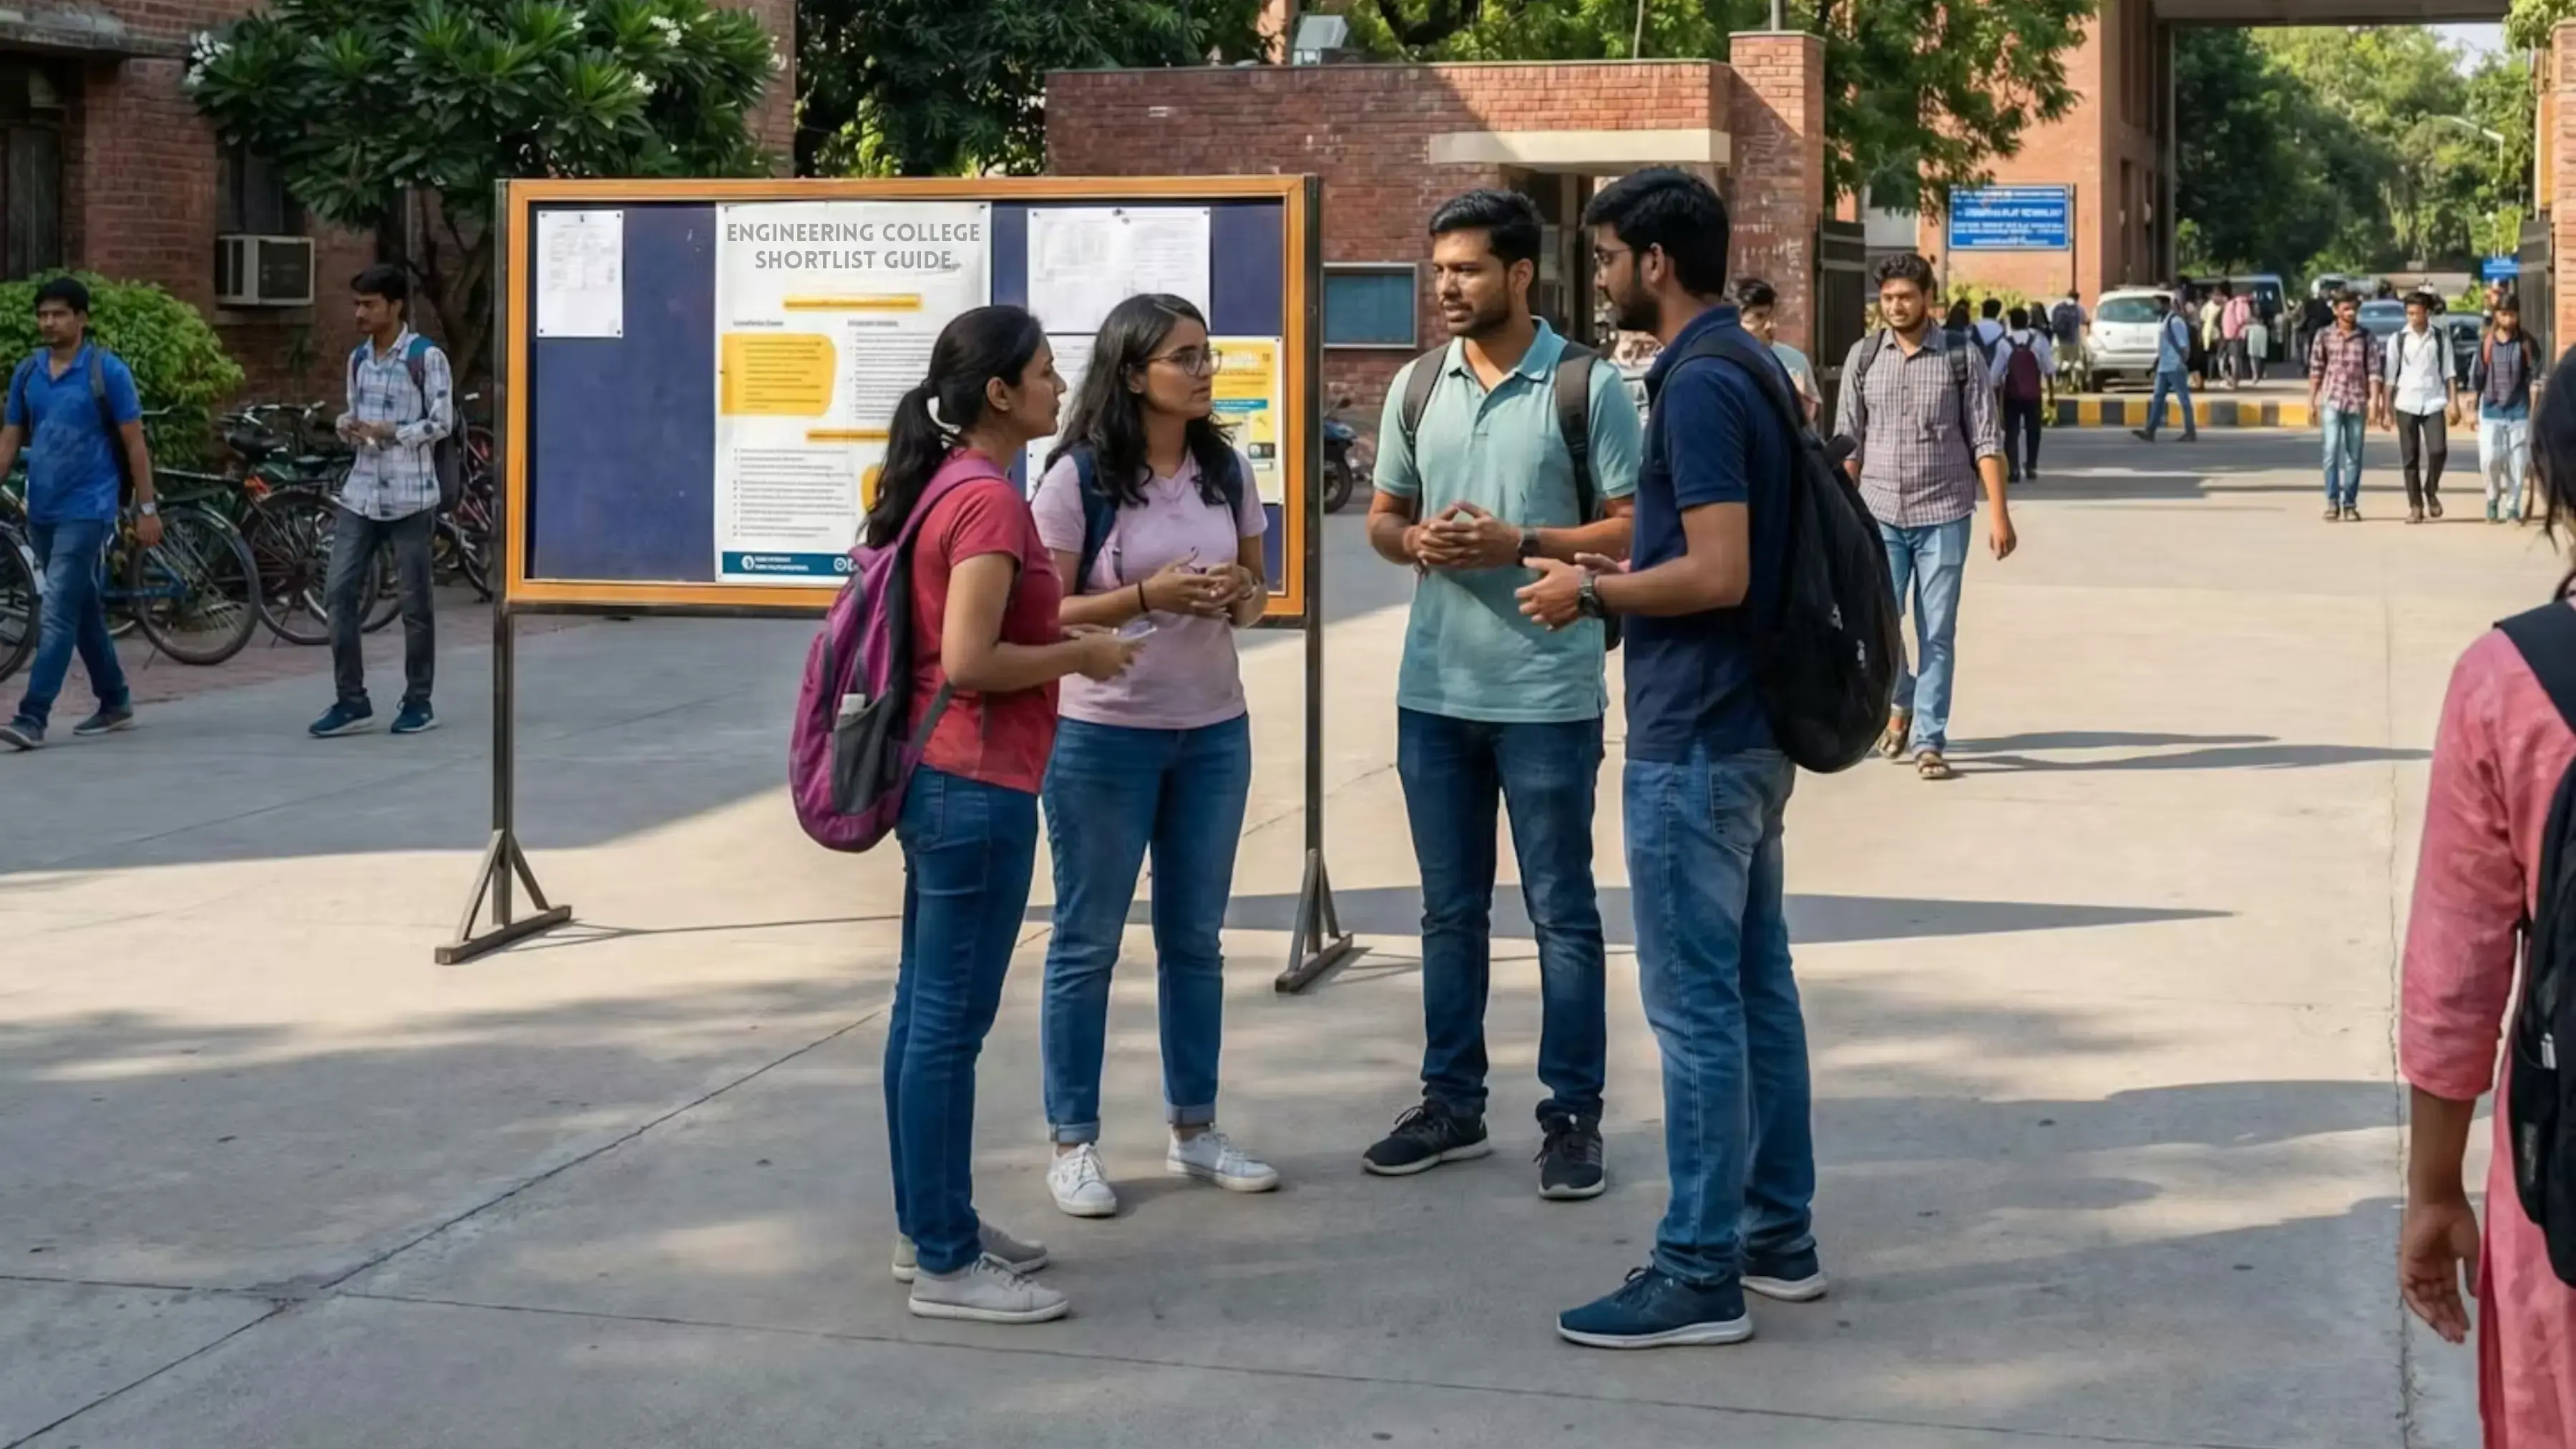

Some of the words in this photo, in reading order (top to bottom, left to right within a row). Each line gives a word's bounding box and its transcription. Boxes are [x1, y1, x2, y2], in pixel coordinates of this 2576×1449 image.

[727, 223, 873, 242] ENGINEERING
[882, 223, 980, 242] COLLEGE
[755, 250, 876, 269] SHORTLIST
[884, 250, 952, 269] GUIDE
